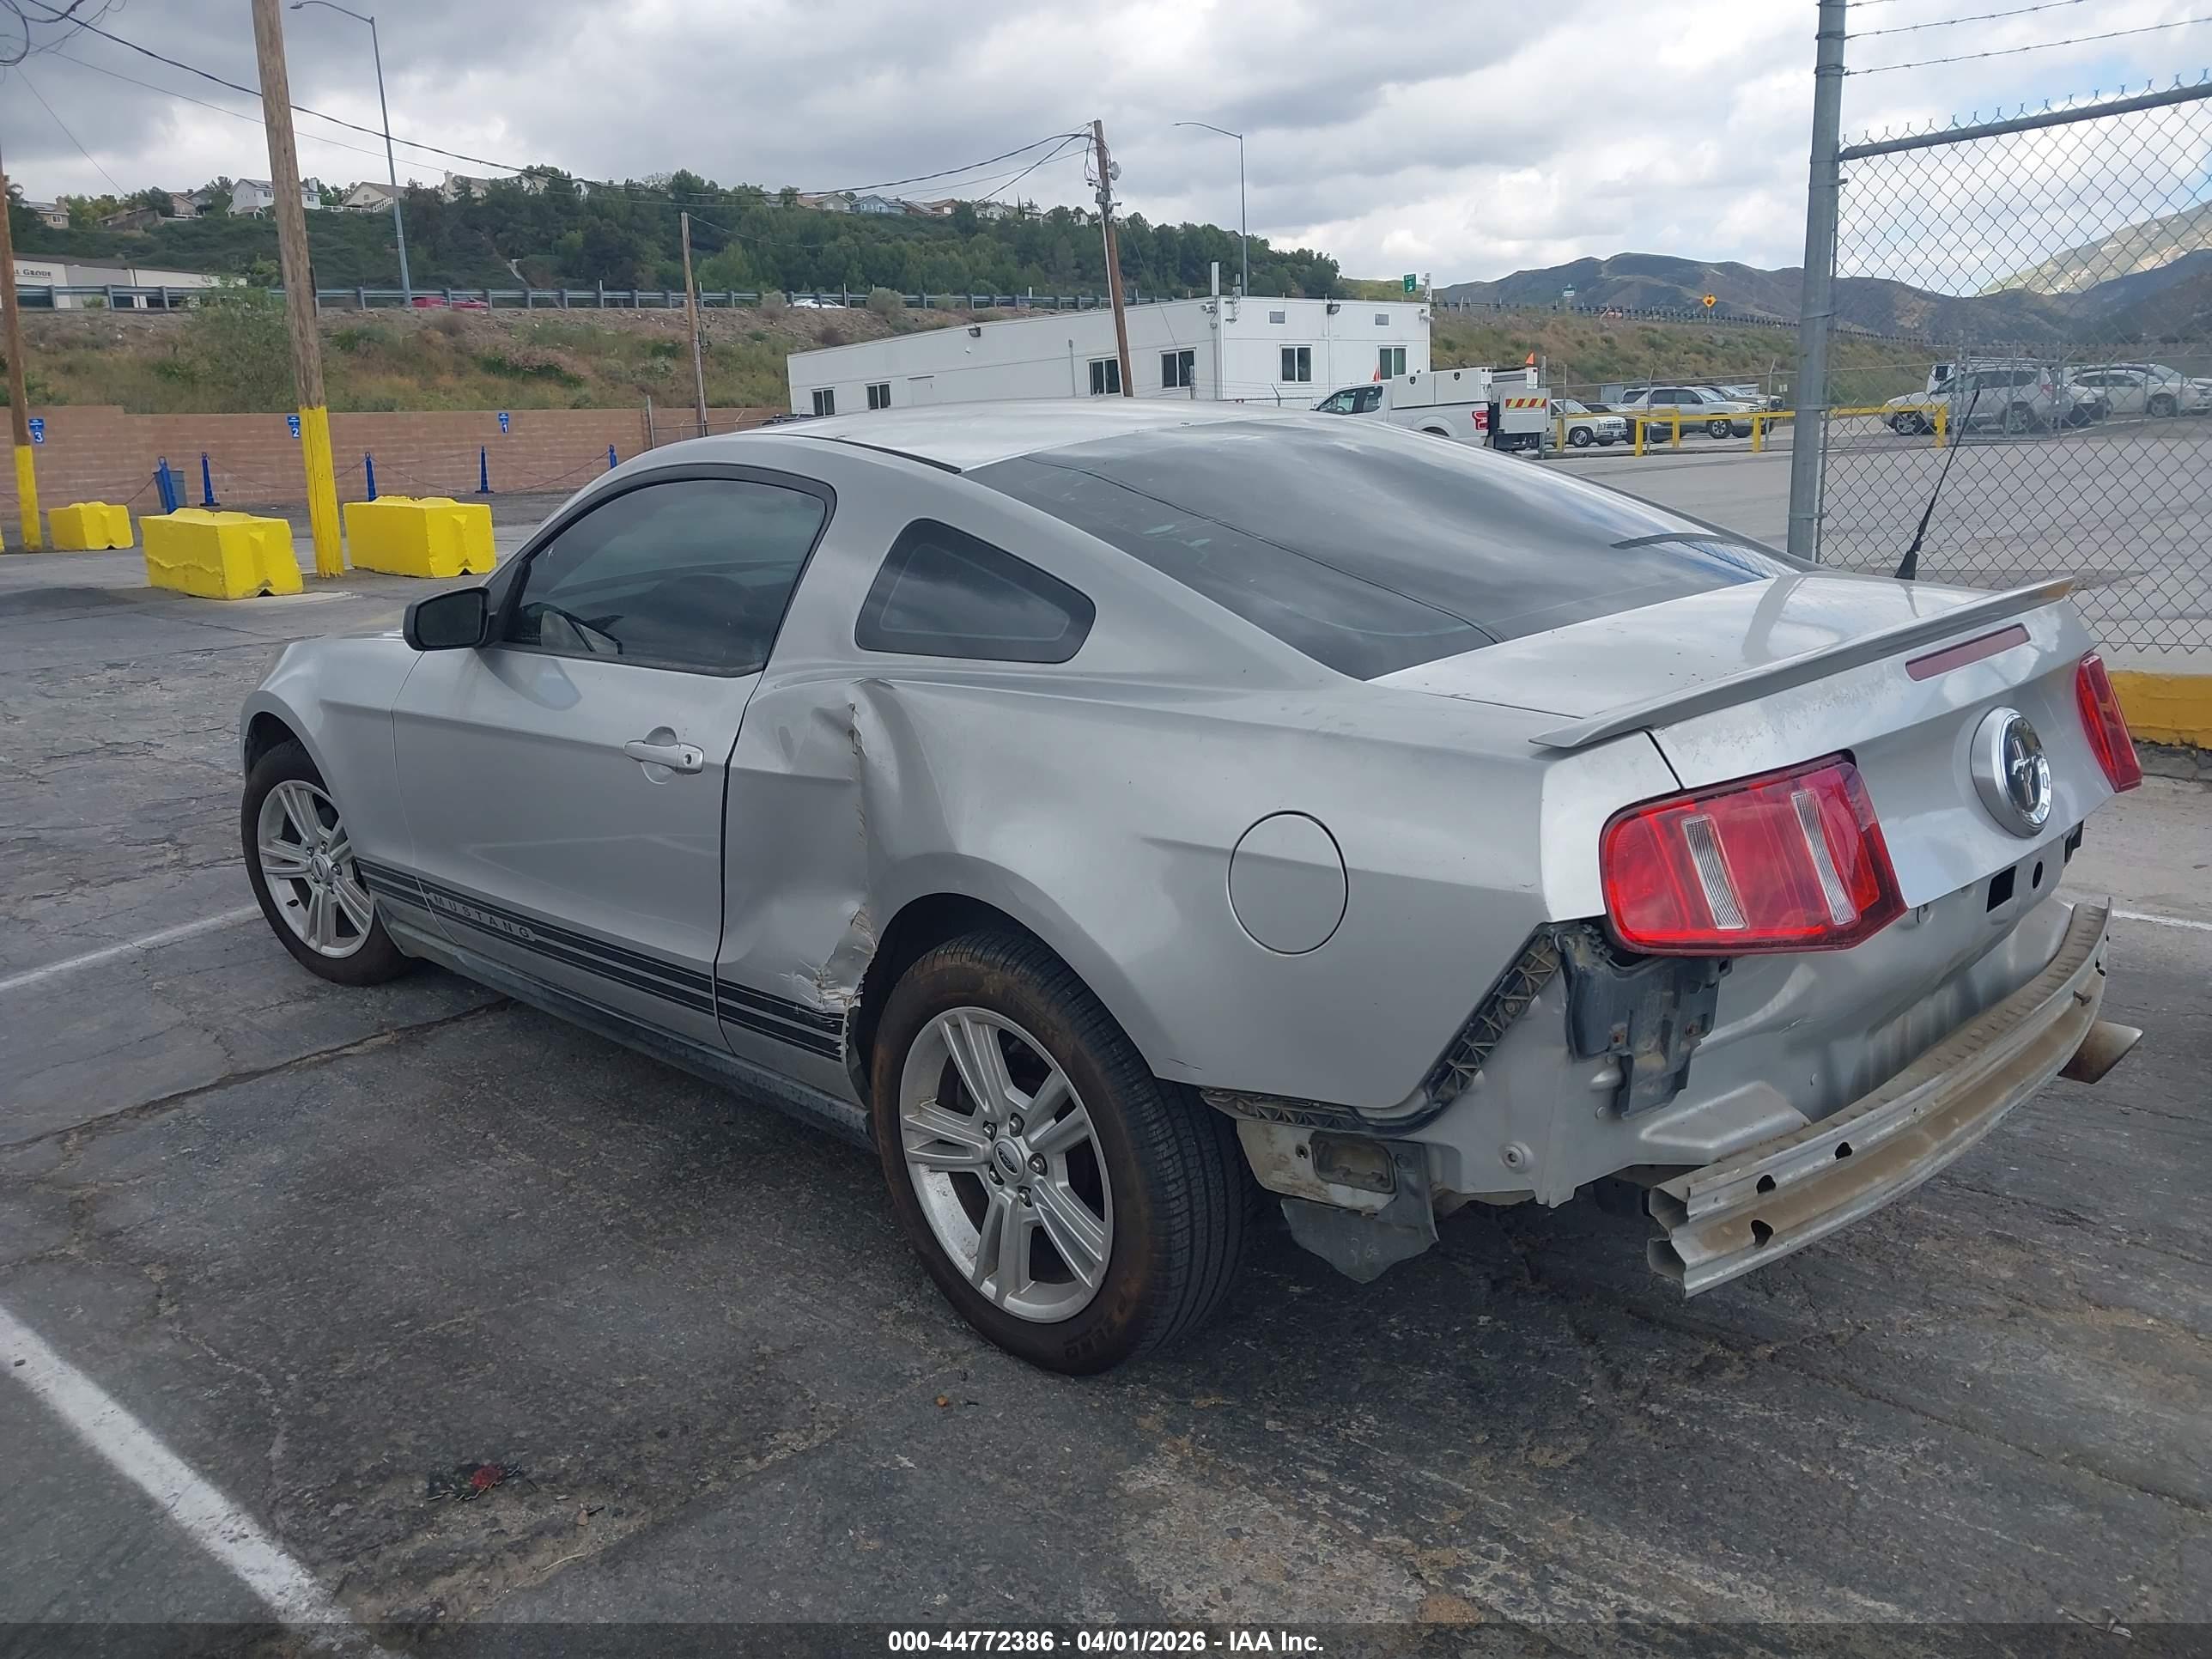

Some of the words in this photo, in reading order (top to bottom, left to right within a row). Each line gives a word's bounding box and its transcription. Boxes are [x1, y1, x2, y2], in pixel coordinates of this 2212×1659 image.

[292, 428, 300, 437] 2
[502, 423, 508, 433] 1
[34, 431, 43, 442] 3
[434, 895, 531, 939] MUSTANG
